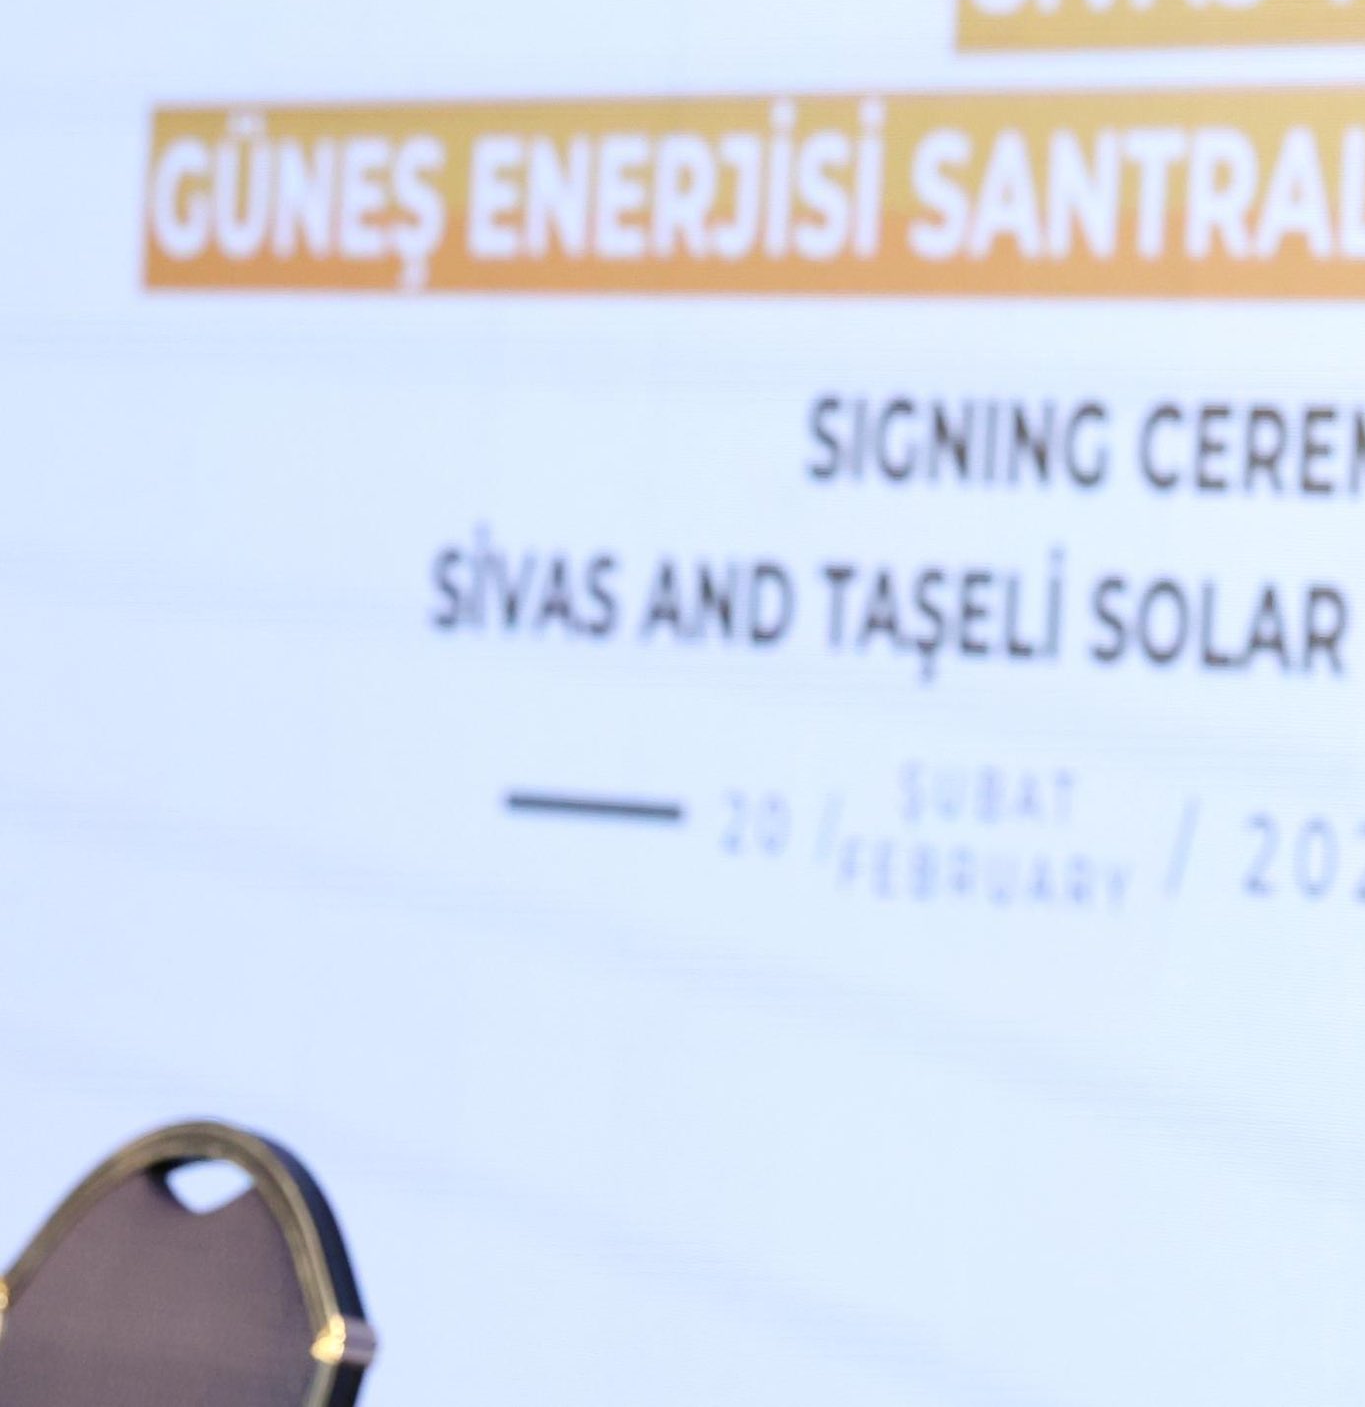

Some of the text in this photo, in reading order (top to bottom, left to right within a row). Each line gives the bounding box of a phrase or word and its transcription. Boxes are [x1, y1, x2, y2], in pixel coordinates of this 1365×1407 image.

[149, 111, 446, 292] GÜNEŞ
[466, 95, 883, 260] ENERJİSİ
[808, 394, 1111, 489] SIGNING
[431, 521, 617, 640] SİVAS
[640, 558, 795, 650] AND
[818, 544, 1068, 685] TAŞELİ
[1090, 573, 1350, 675] SOLAR
[717, 786, 793, 859] 20
